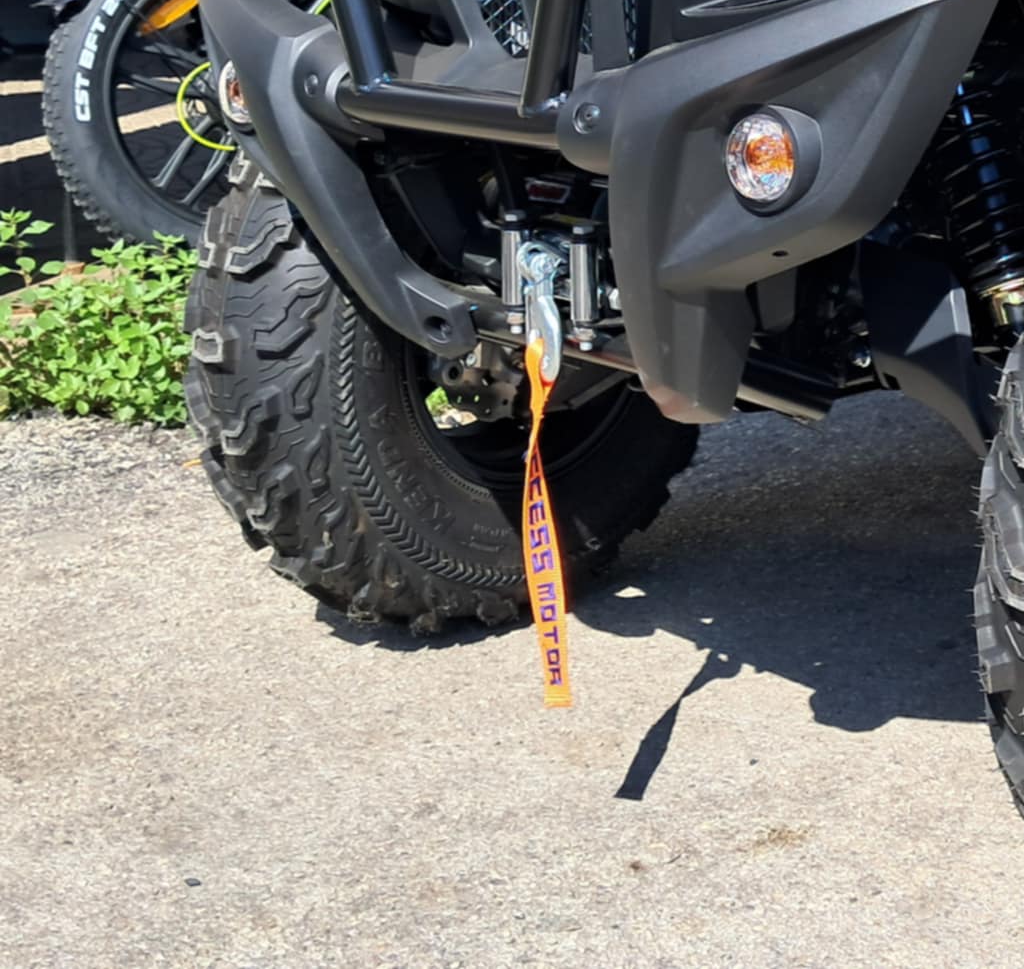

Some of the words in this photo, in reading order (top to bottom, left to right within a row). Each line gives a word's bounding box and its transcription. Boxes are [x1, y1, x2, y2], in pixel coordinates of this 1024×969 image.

[78, 15, 106, 60] BFT
[74, 71, 92, 122] CST
[537, 582, 563, 686] MOTOR
